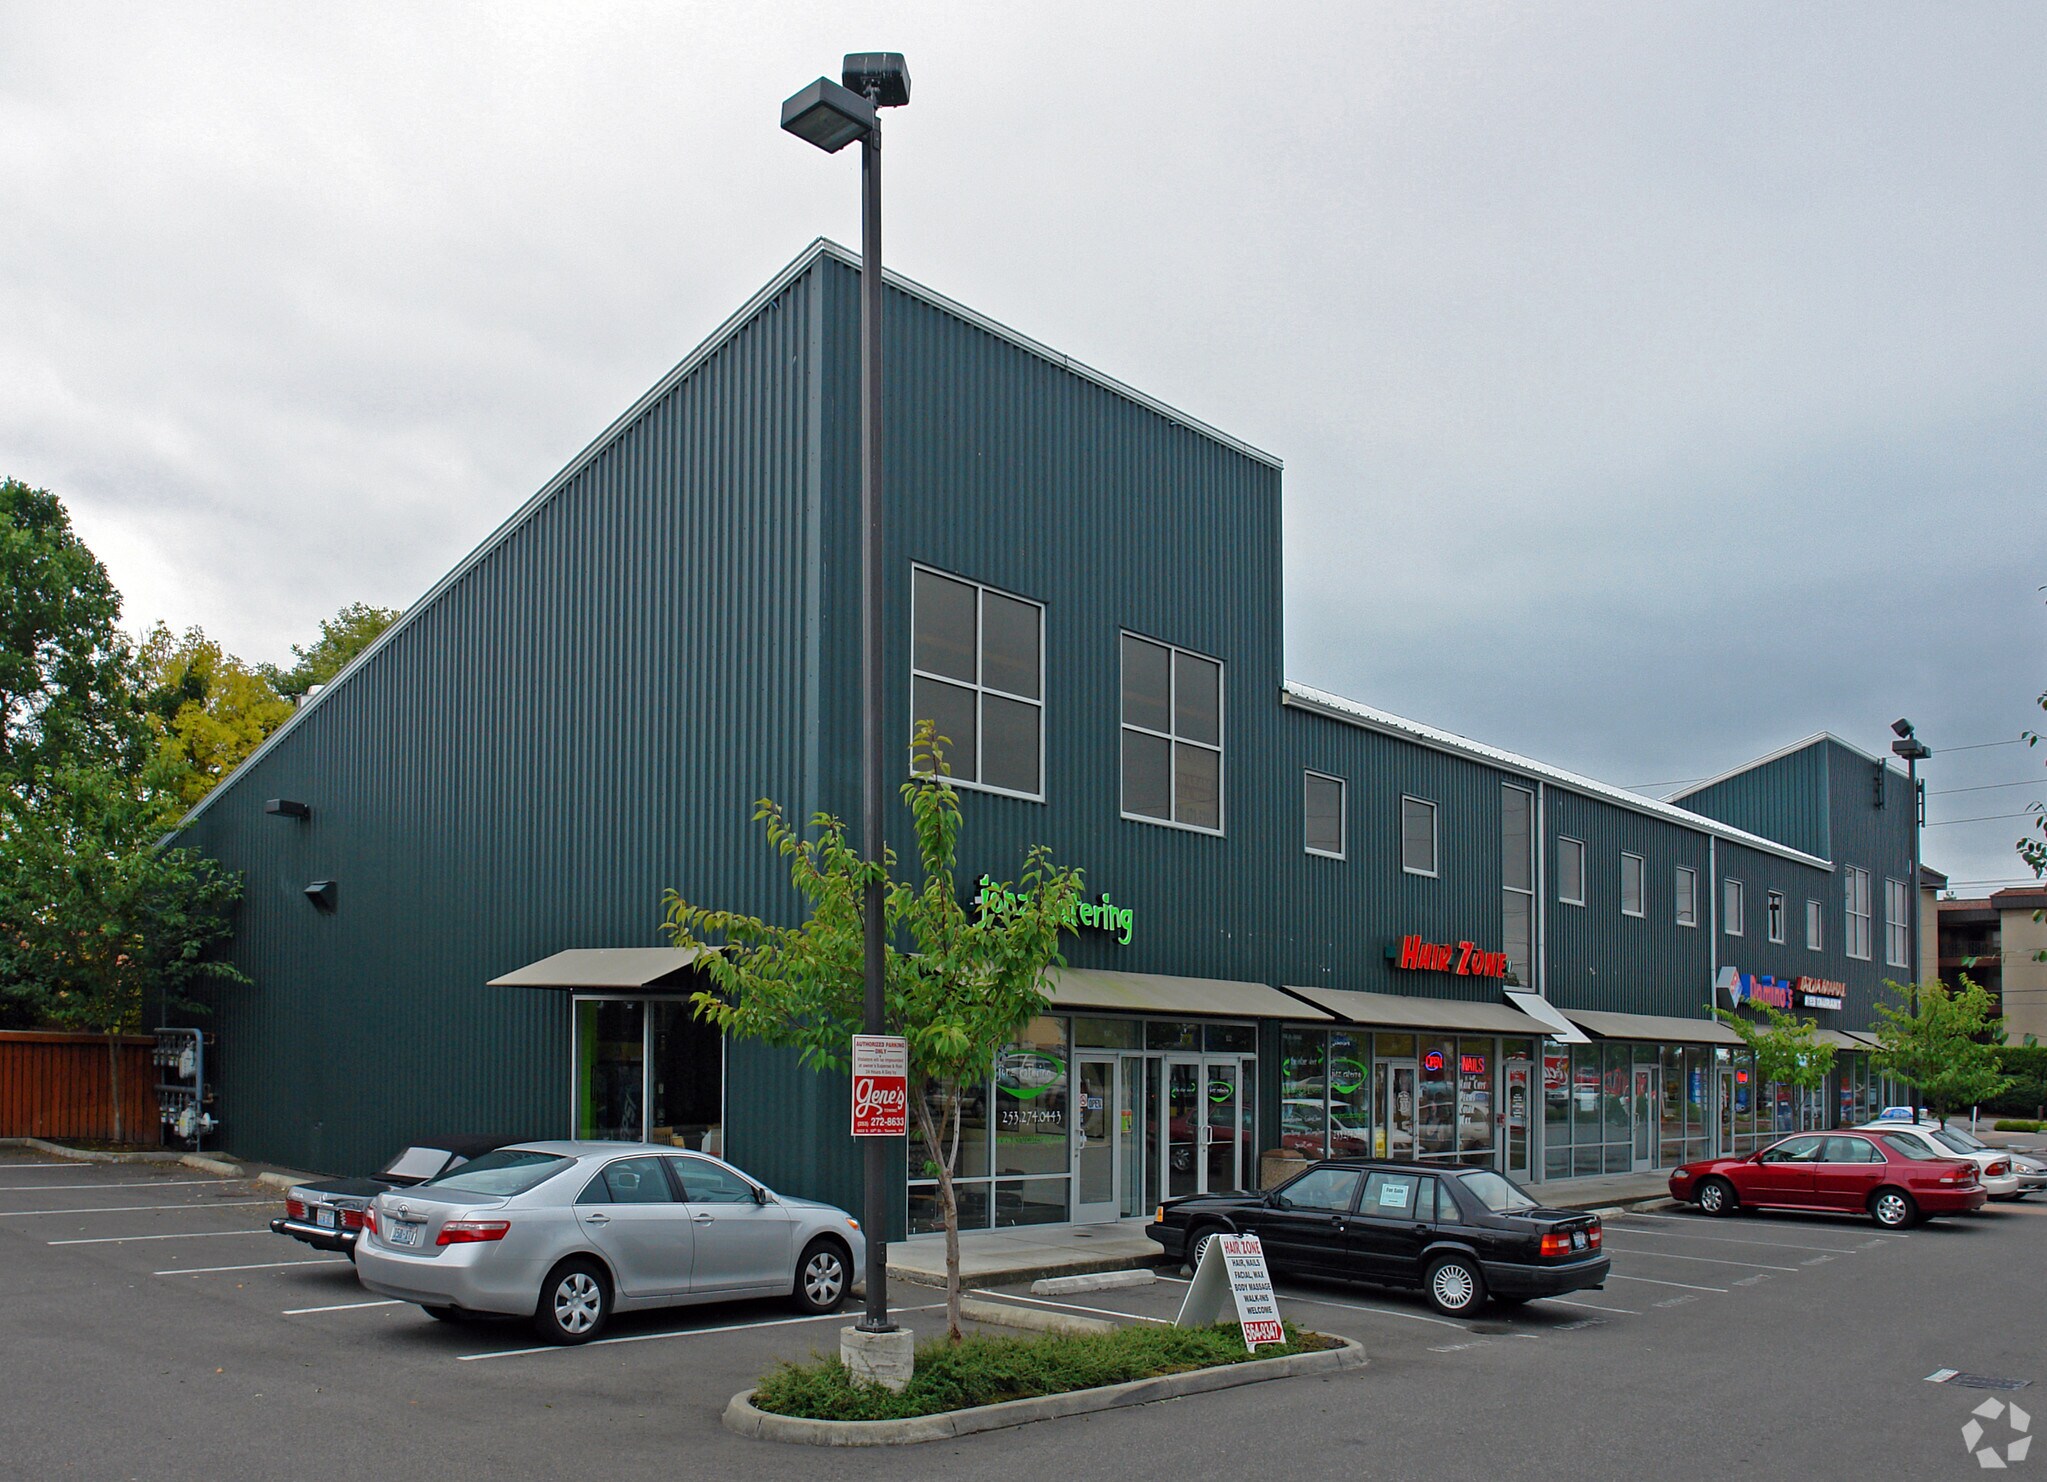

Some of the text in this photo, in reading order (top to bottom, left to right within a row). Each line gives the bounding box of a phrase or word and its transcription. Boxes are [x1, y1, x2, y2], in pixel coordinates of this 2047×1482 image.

[1051, 893, 1133, 946] tering
[1401, 934, 1507, 978] HAIR ZONE
[1748, 974, 1793, 1009] Domino's
[1461, 1056, 1485, 1073] NAILS
[870, 1117, 905, 1127] 272-8633
[1224, 1241, 1261, 1254] HAIR ZONE
[1246, 1259, 1261, 1267] NAILS
[1234, 1282, 1272, 1292] BODY MASSAGE
[1243, 1294, 1269, 1302] WALK-INS
[1246, 1306, 1273, 1315] WELCOME
